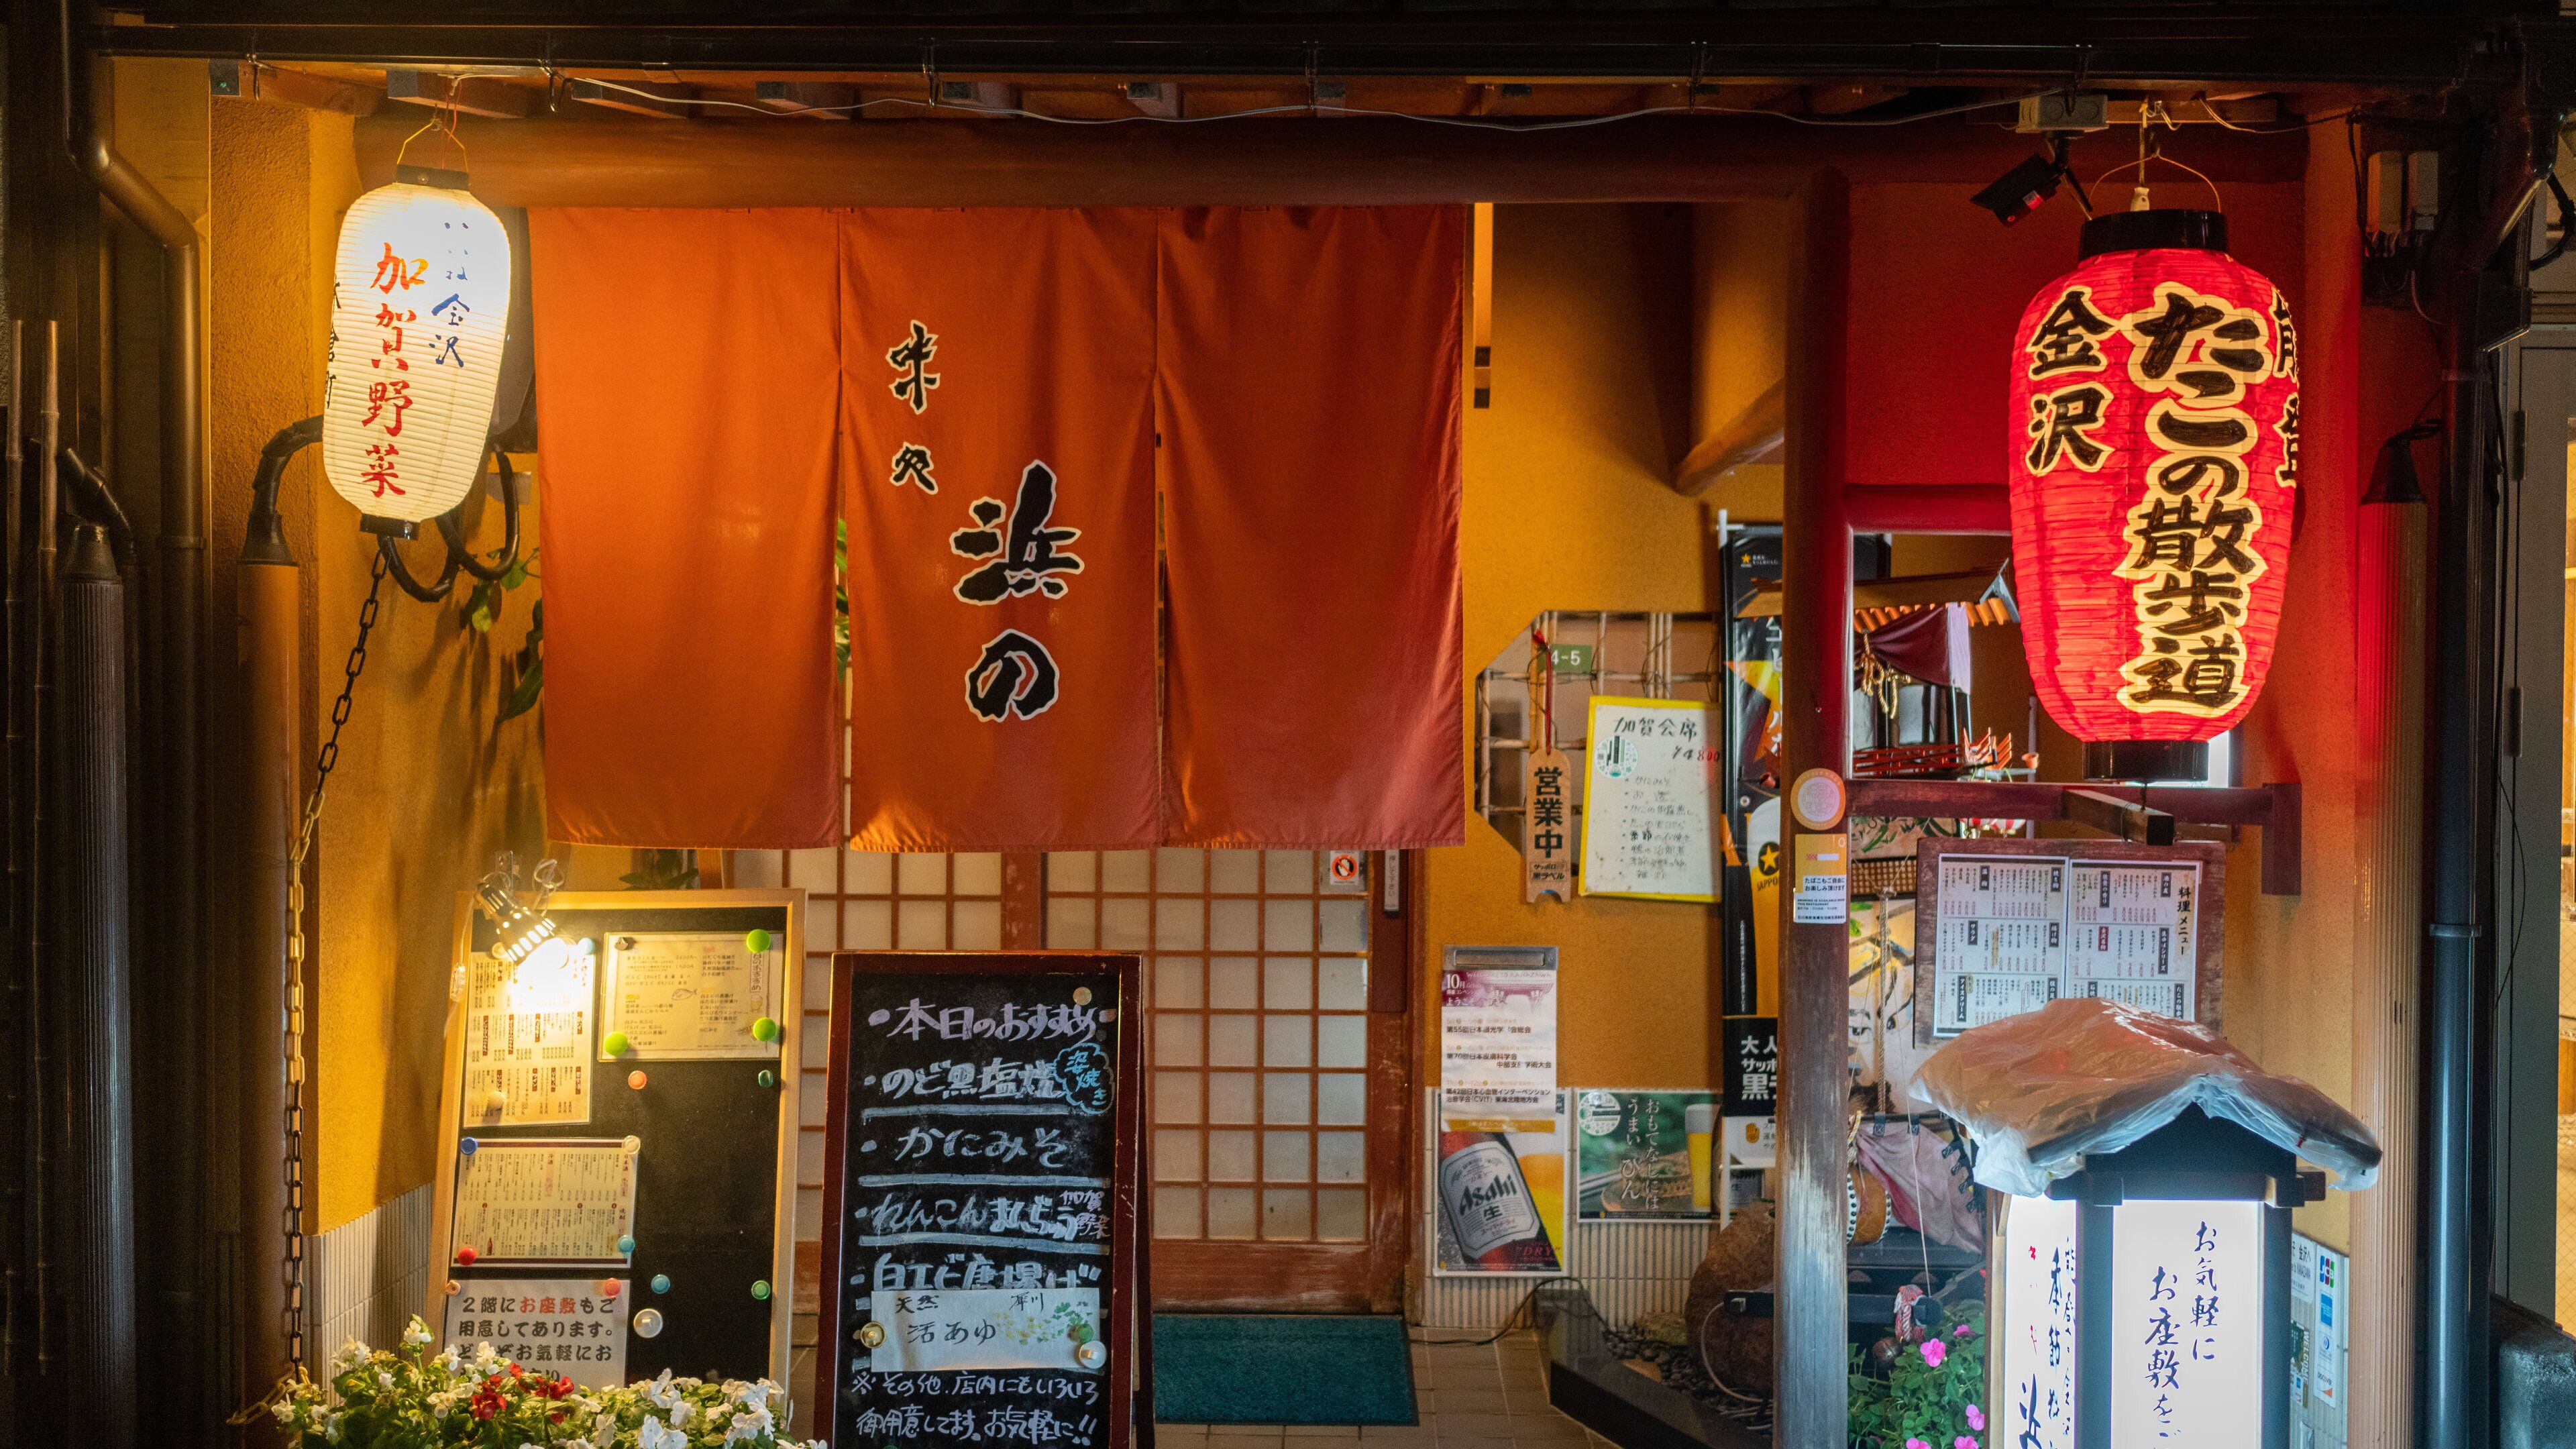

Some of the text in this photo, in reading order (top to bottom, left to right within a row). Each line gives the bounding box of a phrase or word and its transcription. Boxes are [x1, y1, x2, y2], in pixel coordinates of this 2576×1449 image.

[362, 242, 429, 498] 加賀野菜
[2027, 287, 2114, 474] 金沢
[2123, 287, 2269, 712] たこの散歩道
[950, 460, 1084, 722] 浜の
[1613, 717, 1697, 742] 加賀会席
[1534, 767, 1563, 859] 営業中
[2178, 885, 2192, 955] 料理メニュー
[1446, 973, 1465, 989] 10月
[887, 998, 1097, 1042] 本日のおすすめ
[894, 1126, 1068, 1168] かにみそ
[1621, 1097, 1642, 1200] うまい びん
[1646, 1098, 1660, 1210] おもてなしには
[1059, 1190, 1105, 1211] 加賀
[1460, 1175, 1517, 1216] Asahi
[1483, 1205, 1503, 1221] 生
[873, 1252, 1102, 1291] 白エビ唐揚げ
[2190, 1221, 2219, 1360] お気軽に
[2320, 1254, 2334, 1289] JCB
[462, 1297, 614, 1315] 2階にお座敷もご
[894, 1295, 939, 1313] 天然
[459, 1320, 613, 1338] 用意してあります。
[907, 1320, 997, 1346] 活あゆ
[458, 1344, 612, 1362] どぞお気軽にお
